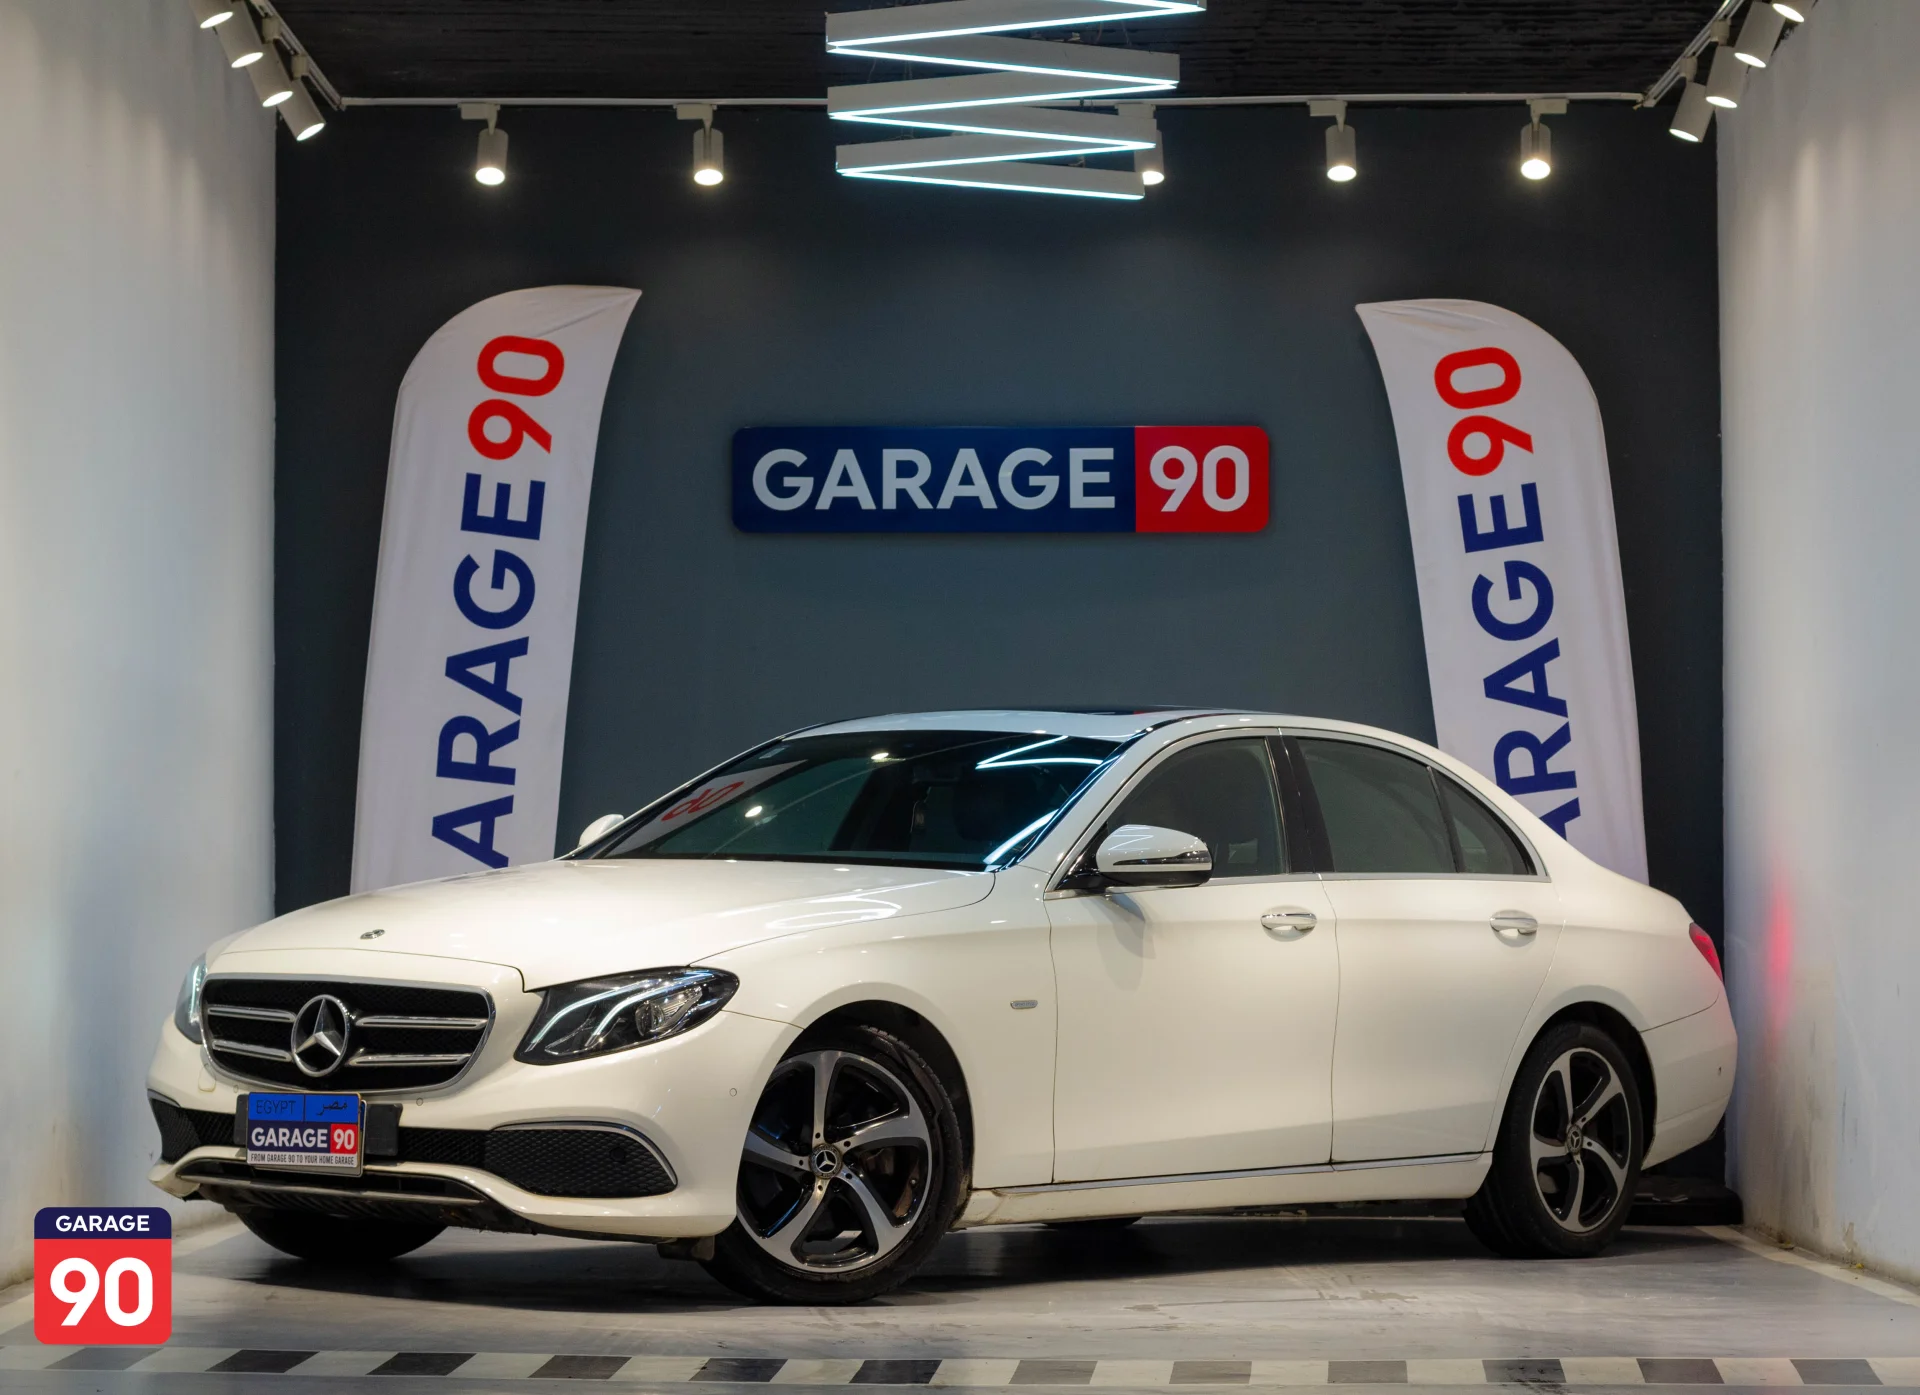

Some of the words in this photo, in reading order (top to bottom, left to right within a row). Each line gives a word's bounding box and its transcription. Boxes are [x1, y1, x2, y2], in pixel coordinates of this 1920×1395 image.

[467, 335, 565, 460] 90
[1434, 346, 1534, 476] 90
[752, 447, 1115, 511] GARAGE
[1149, 444, 1250, 512] 90
[432, 473, 545, 868] ARAGE
[1457, 482, 1581, 841] RAGE
[251, 1127, 328, 1148] GARAGE
[333, 1128, 355, 1150] 90
[256, 1100, 296, 1114] EGYPT
[316, 1100, 348, 1116] مصر
[251, 1153, 265, 1162] FROM
[267, 1154, 287, 1163] GARAGE
[288, 1155, 295, 1163] 90
[296, 1155, 304, 1163] TO
[304, 1155, 318, 1164] YOUR
[319, 1156, 334, 1164] HOME
[335, 1156, 354, 1165] GARAGE
